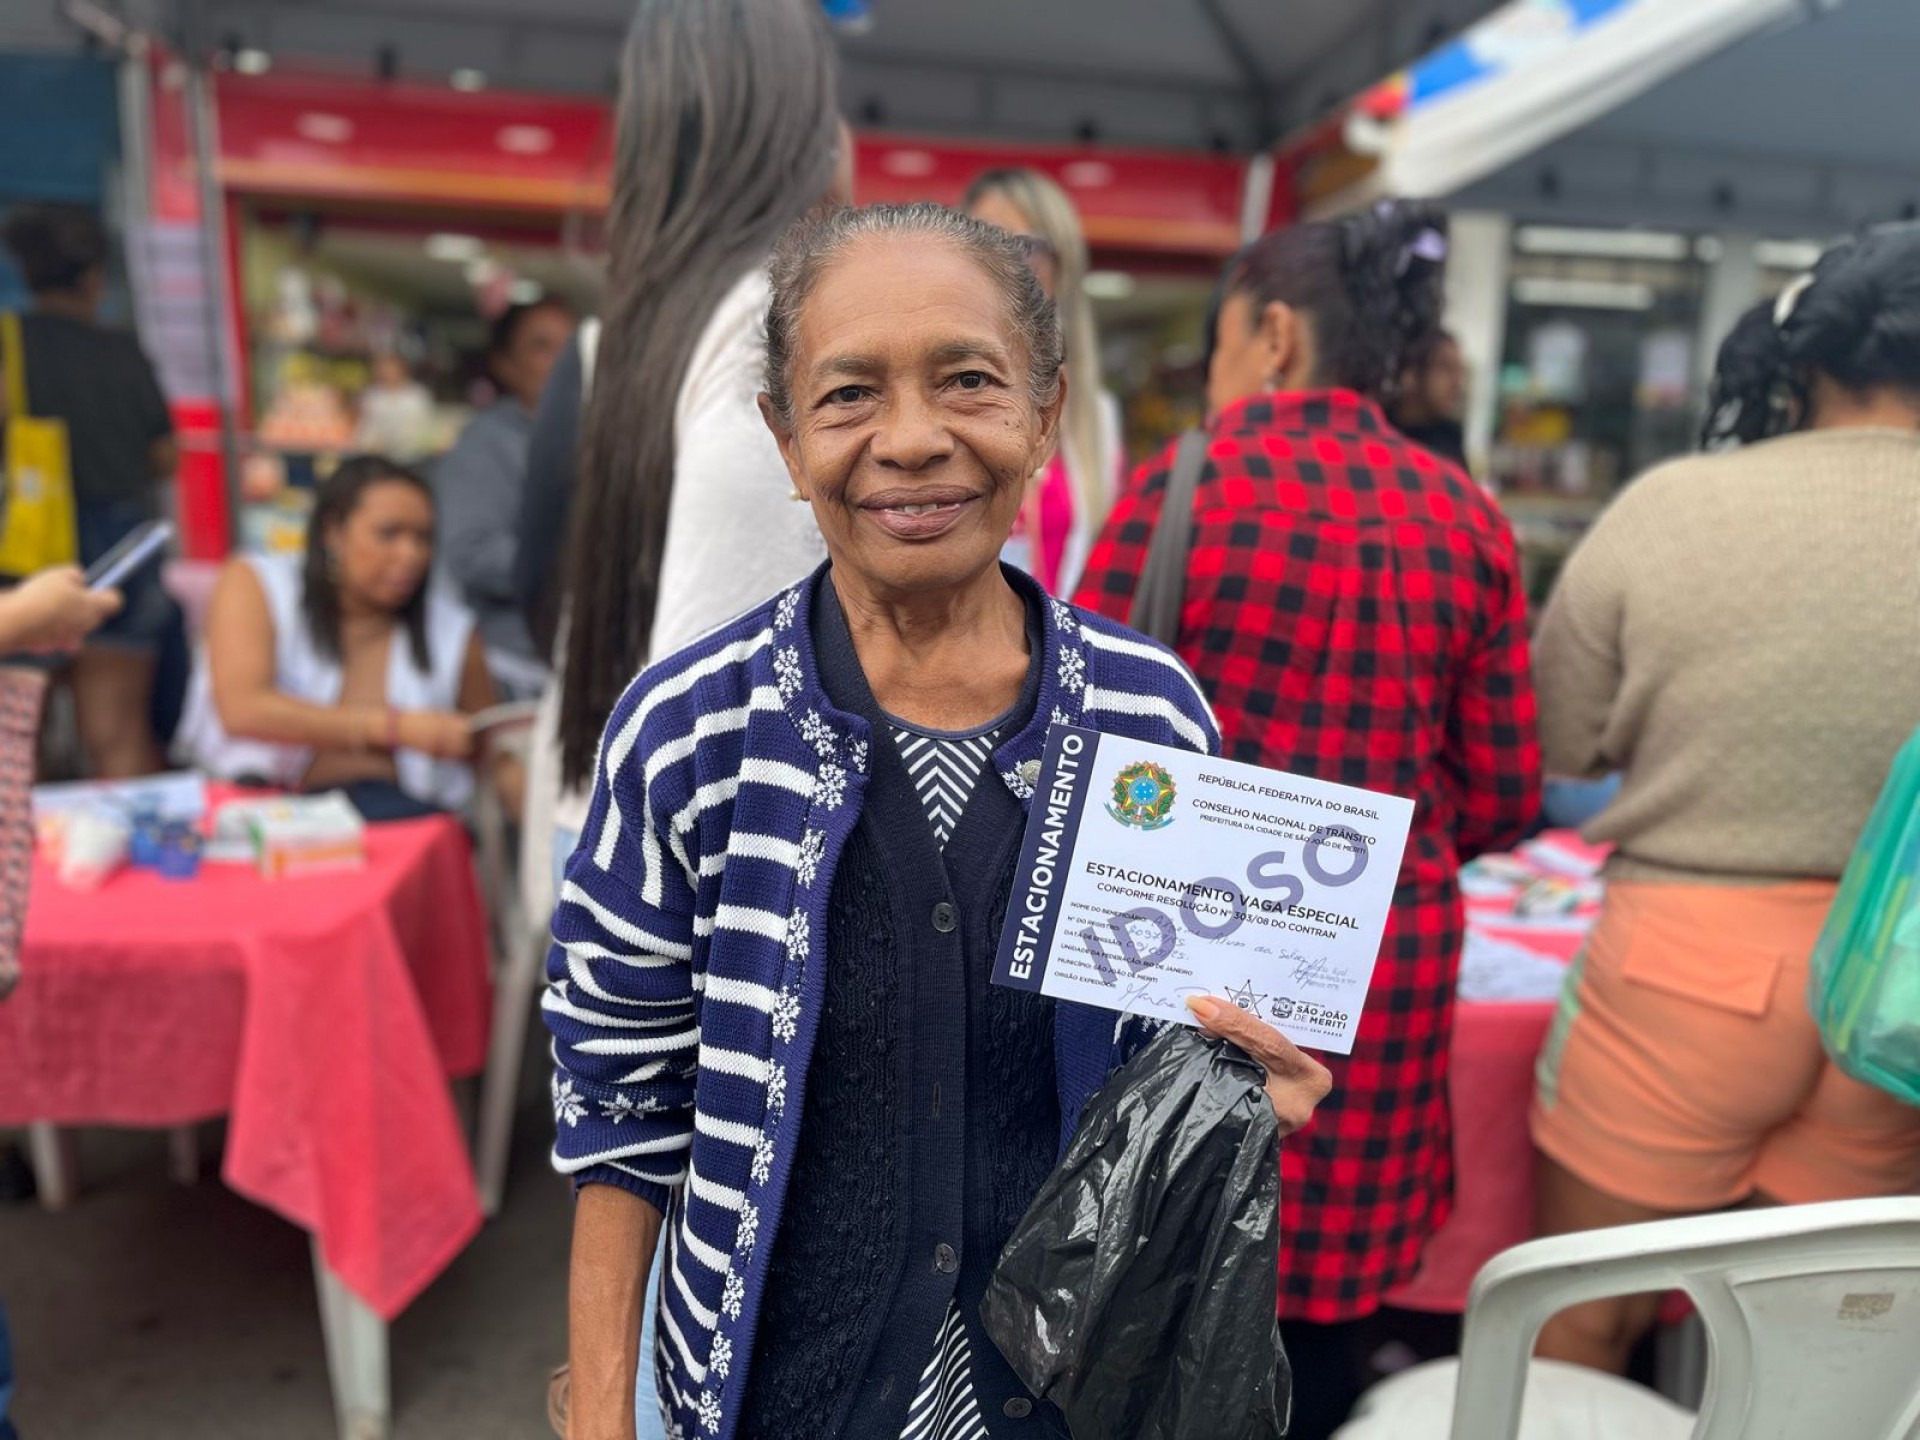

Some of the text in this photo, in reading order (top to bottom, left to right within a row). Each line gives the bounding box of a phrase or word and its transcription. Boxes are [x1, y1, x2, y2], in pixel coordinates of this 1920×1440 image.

[1198, 772, 1380, 819] REPÚBLICA FEDERATIVA DO BRASIL
[1191, 798, 1377, 845] CONSELHO NACIONAL DE TRÂNSITO
[1199, 813, 1242, 828] PREFEITURA
[1255, 825, 1282, 836] CIDADE
[1283, 831, 1294, 839] DE
[1295, 832, 1310, 842] SÃO
[1310, 836, 1331, 847] JOÃO
[1331, 841, 1341, 849] DE
[1342, 844, 1366, 855] MERITI
[1009, 734, 1084, 980] ESTACIONAMENTO
[1070, 901, 1089, 910] NOME
[1080, 824, 1369, 985] IDOSO
[1085, 861, 1360, 929] ESTACIONAMENTO VAGA ESPECIAL
[1096, 881, 1154, 901] CONFORME
[1156, 893, 1218, 915] RESOLUÇÃO
[1233, 911, 1269, 926] 303/08
[1271, 919, 1285, 929] DO
[1287, 922, 1336, 939] CONTRAN
[1063, 929, 1082, 938] DATA
[1060, 943, 1089, 954] UNIDADE
[1165, 965, 1192, 976] JANEIRO
[1092, 963, 1107, 972] SÃO
[1108, 966, 1126, 976] JOÃO
[1136, 973, 1158, 983] MERITI
[1293, 1013, 1346, 1030] DE MERITI
[1296, 1003, 1348, 1021] SÃO JOÃO
